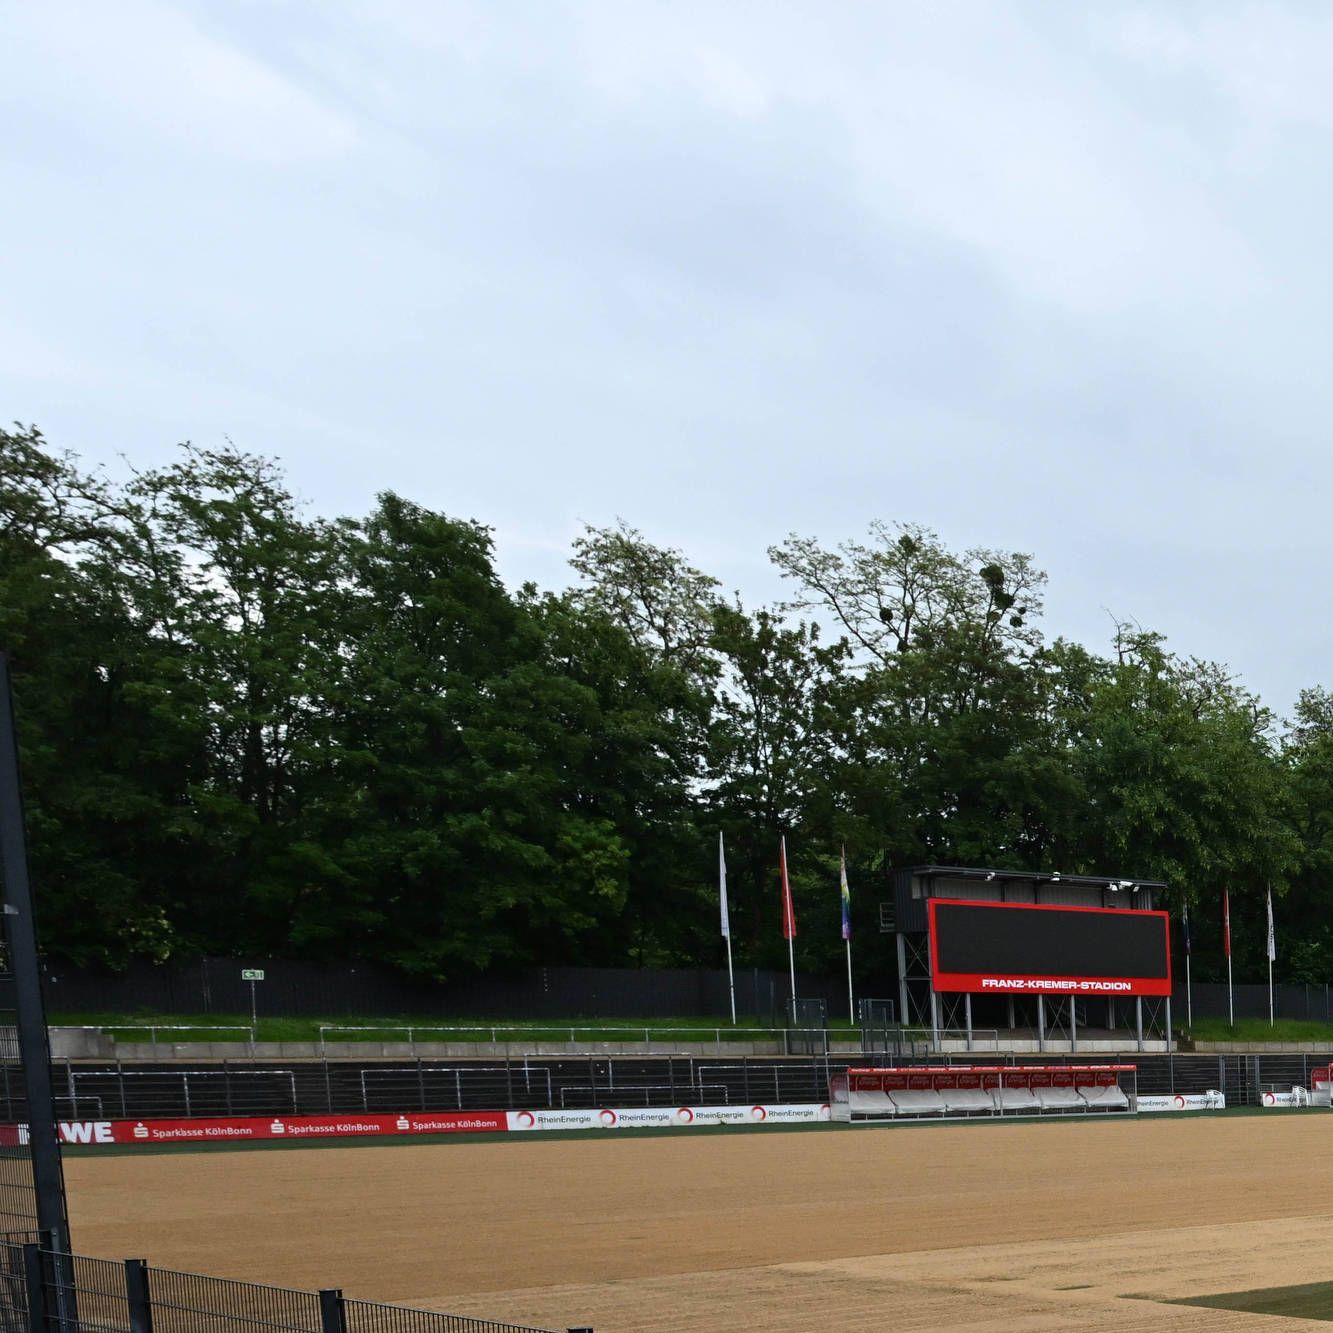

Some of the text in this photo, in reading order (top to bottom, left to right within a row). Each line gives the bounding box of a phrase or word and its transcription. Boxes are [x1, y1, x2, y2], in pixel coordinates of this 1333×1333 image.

[982, 979, 1132, 990] FRANZ-KREMER-STADION
[619, 1113, 669, 1121] RheinEnergie
[695, 1112, 744, 1120] RheinEnergie
[768, 1110, 814, 1118] RheinEnergie
[412, 1119, 497, 1130] Sparkasse KölnBonn
[537, 1116, 591, 1124] RheinEnergie
[153, 1126, 252, 1139] Sparkasse KölnBonn
[288, 1122, 380, 1134] Sparkasse KölnBonn
